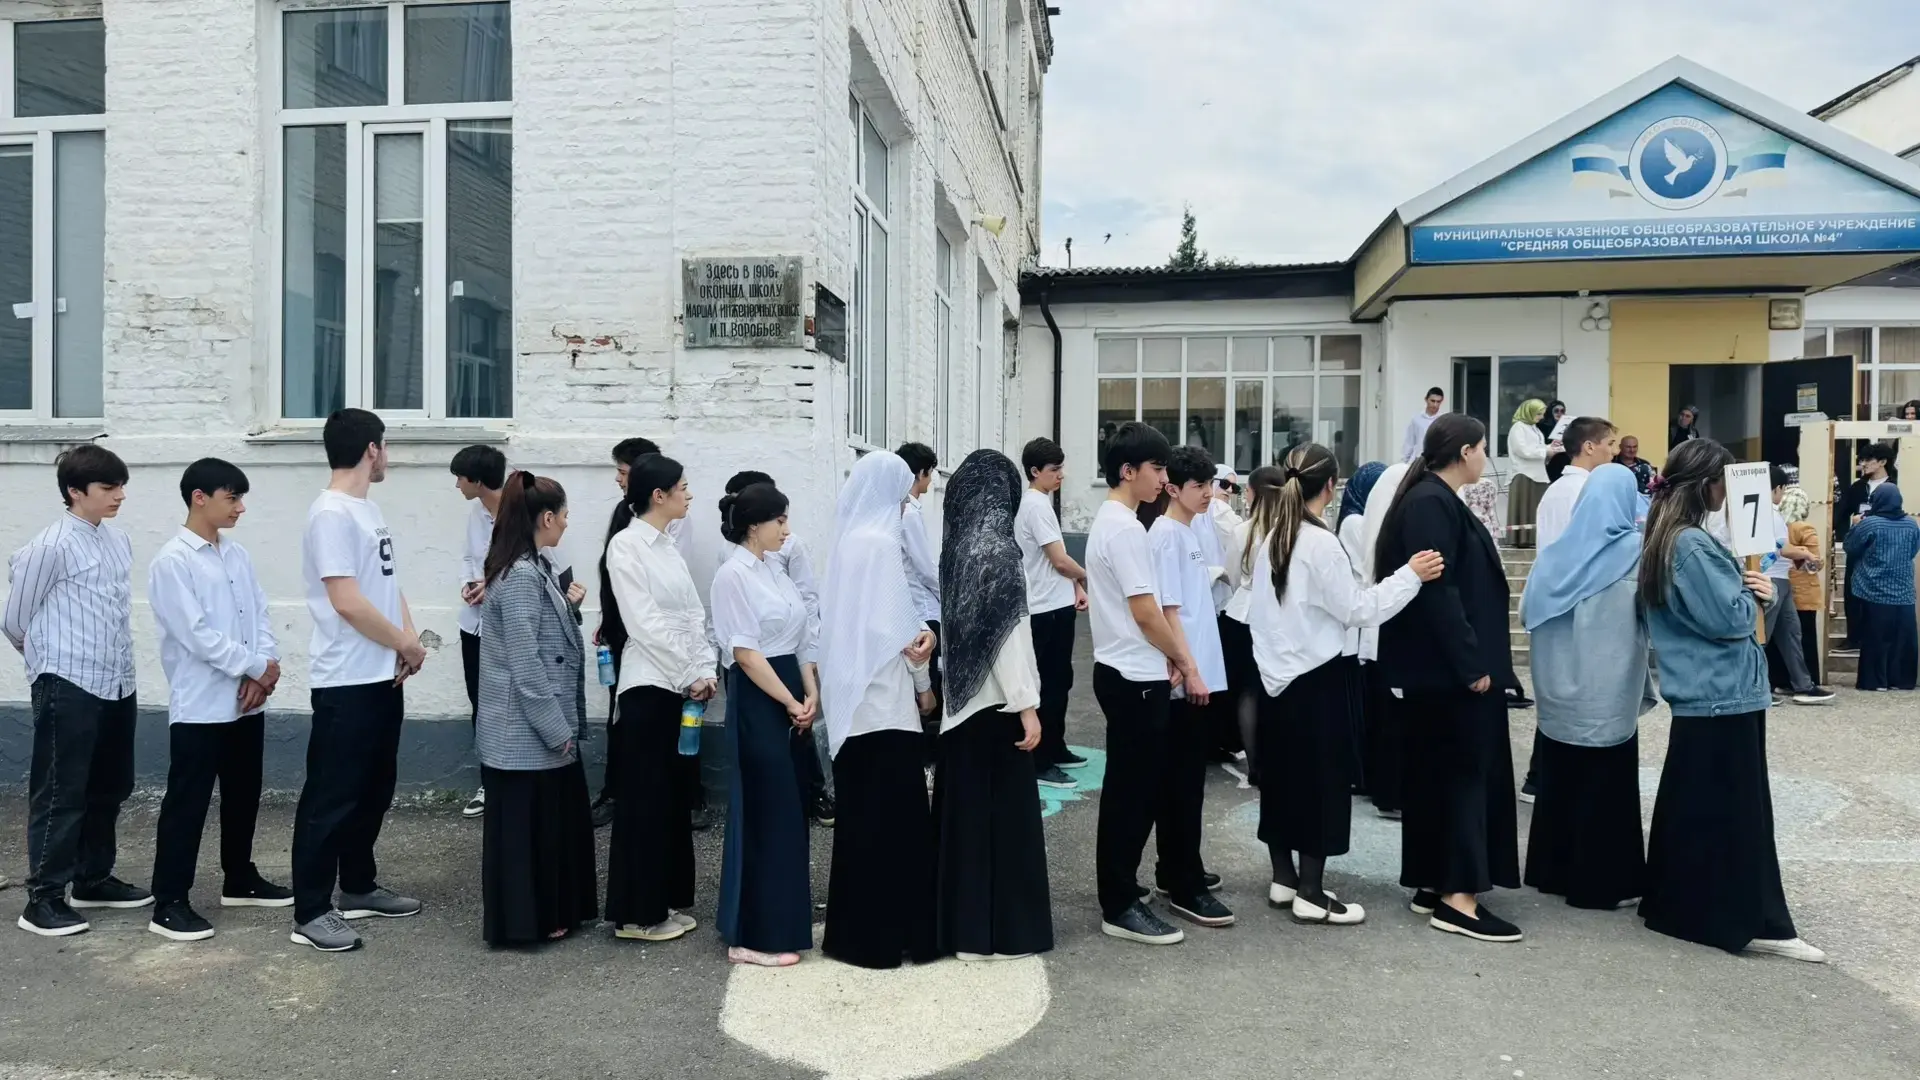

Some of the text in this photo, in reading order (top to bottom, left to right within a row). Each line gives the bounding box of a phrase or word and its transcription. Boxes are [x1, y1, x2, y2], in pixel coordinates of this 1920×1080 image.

[1433, 217, 1917, 242] МУНИЦИПАЛЬНОЕ КАЗЕННОЕ ОБЩЕОБРАЗОВАТЕЛЬНОЕ УЧРЕЖДЕНИЕ
[1501, 239, 1569, 252] "СРЕДНЯЯ
[1572, 234, 1752, 250] ОБЩЕОБРАЗОВАТЕЛЬНАЯ
[1756, 233, 1811, 245] ШКОЛА
[1731, 467, 1767, 479] Аудитория
[1743, 493, 1760, 538] 7
